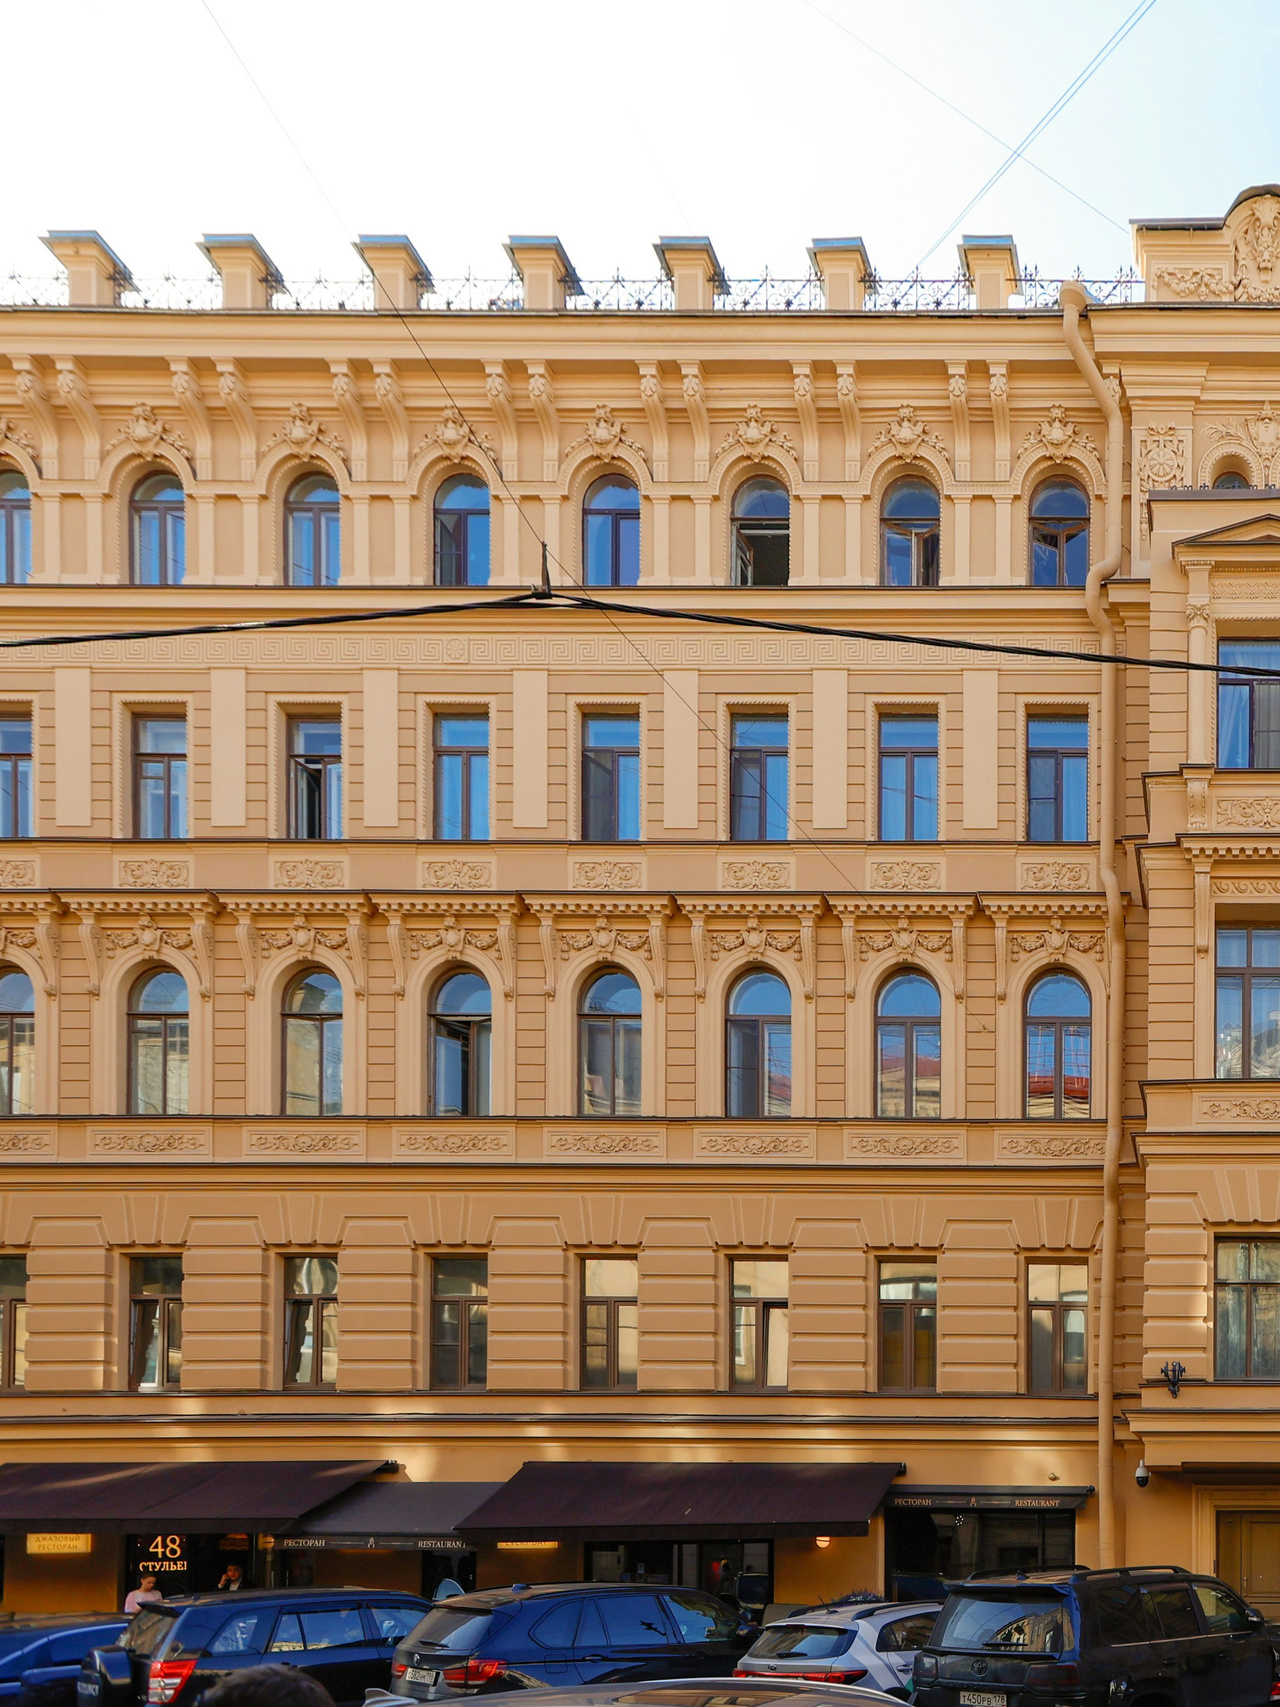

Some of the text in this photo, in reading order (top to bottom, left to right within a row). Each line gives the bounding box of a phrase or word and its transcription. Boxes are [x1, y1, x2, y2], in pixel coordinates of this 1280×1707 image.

[894, 1498, 932, 1506] РЕСТОРАН
[1014, 1499, 1060, 1507] RESTAURANT
[35, 1534, 80, 1543] ДЖАЗОВЫЙ
[149, 1535, 181, 1558] 48
[283, 1539, 325, 1547] РЕСТОРАН
